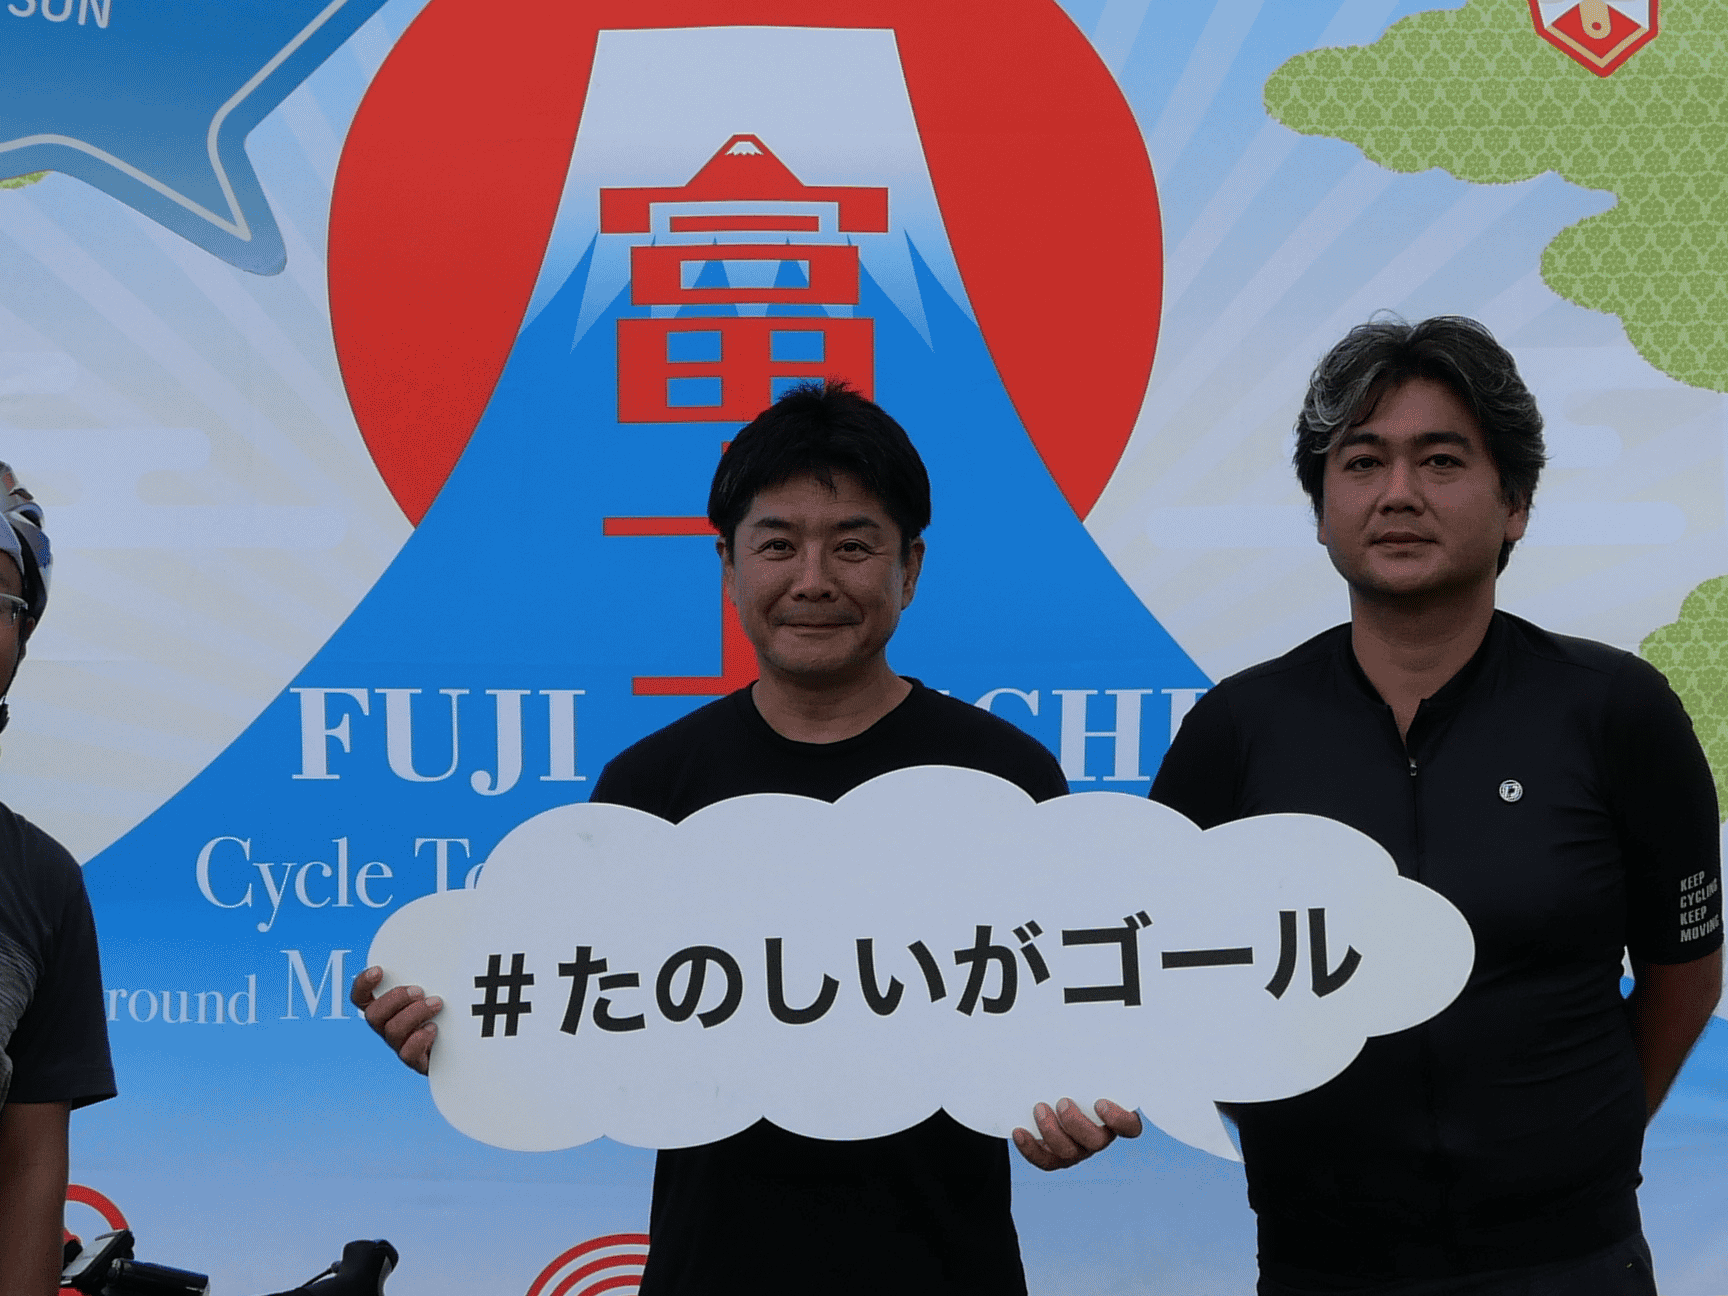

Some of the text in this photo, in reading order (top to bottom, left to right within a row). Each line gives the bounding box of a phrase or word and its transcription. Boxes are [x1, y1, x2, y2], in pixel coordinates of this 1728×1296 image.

[290, 687, 585, 796] FUJI
[195, 836, 395, 932] Cycle
[1679, 905, 1708, 926] KEEP
[1680, 870, 1706, 893] KEEP
[104, 973, 260, 1026] round
[471, 906, 1364, 1040] #たのしいがゴール
